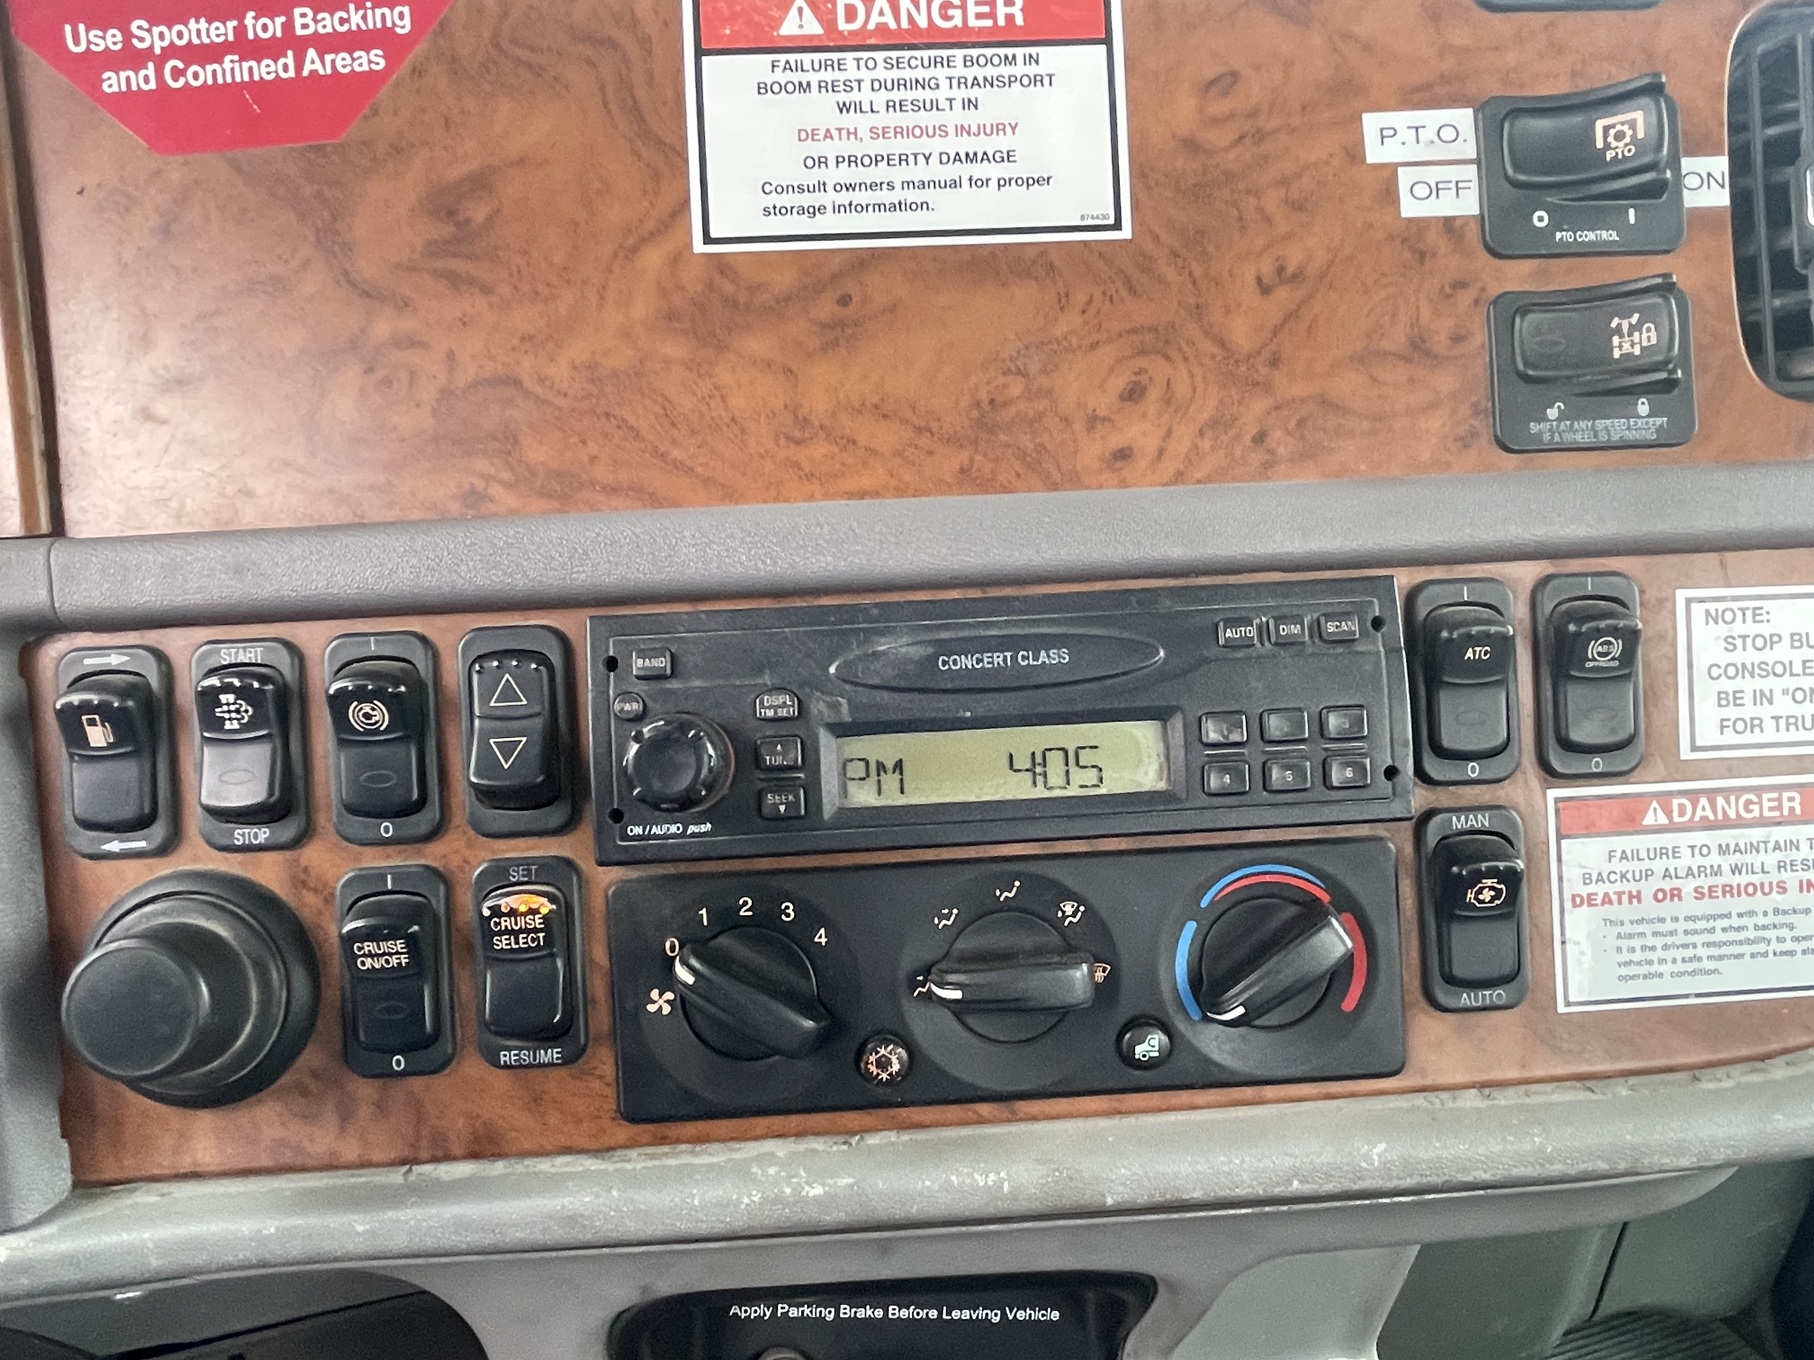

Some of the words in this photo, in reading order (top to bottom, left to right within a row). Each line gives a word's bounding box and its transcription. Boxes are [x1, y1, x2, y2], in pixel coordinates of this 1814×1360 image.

[837, 0, 1024, 31] DANGER
[65, 23, 122, 53] Use
[131, 18, 235, 55] Spotter
[244, 12, 286, 39] for
[294, 2, 411, 35] Backing
[102, 62, 156, 93] and
[164, 53, 295, 88] Confined
[303, 46, 387, 77] Areas
[771, 57, 848, 73] FAILURE
[854, 56, 877, 71] TO
[883, 54, 957, 70] SECURE
[963, 53, 1017, 68] BOOM
[1023, 52, 1040, 66] IN
[757, 80, 812, 95] BOOM
[818, 78, 864, 93] REST
[870, 76, 940, 92] DURING
[945, 73, 1055, 89] TRANSPORT
[836, 99, 879, 114] WILL
[885, 97, 956, 113] RESULT
[962, 97, 979, 111] IN
[797, 127, 863, 143] DEATH,
[869, 125, 949, 140] SERIOUS
[954, 122, 1019, 138] INJURY
[1380, 123, 1467, 146] P.T.O.
[803, 155, 829, 170] OR
[835, 152, 933, 168] PROPERTY
[939, 149, 1017, 165] DAMAGE
[1605, 145, 1635, 162] PTO
[761, 180, 828, 196] Consult
[834, 179, 895, 193] owners
[901, 176, 962, 191] manual
[968, 174, 992, 189] for
[998, 174, 1053, 191] proper
[1683, 171, 1725, 190] ON
[1410, 180, 1472, 201] OFF
[763, 201, 827, 218] storage
[832, 197, 935, 214] information.
[1555, 230, 1574, 242] PTO
[1576, 229, 1619, 241] CONTROL
[1530, 422, 1558, 434] SHIFT
[1559, 421, 1572, 432] AT
[1573, 420, 1593, 431] ANY
[1595, 419, 1627, 430] SPEED
[1630, 418, 1668, 429] EXCEPT
[1543, 433, 1552, 443] IF
[1554, 432, 1561, 442] A
[1562, 431, 1596, 442] WHEEL
[1598, 431, 1608, 441] IS
[1610, 429, 1657, 441] SPINNING
[1705, 606, 1770, 625] NOTE:
[1225, 627, 1254, 638] AUTO
[1280, 625, 1301, 635] DIM
[1327, 622, 1355, 632] SCAN
[1723, 633, 1783, 653] STOP
[220, 648, 264, 664] START
[938, 651, 1013, 671] CONCERT
[1017, 649, 1070, 667] CLASS
[1465, 645, 1491, 661] ATC
[636, 658, 666, 668] BAND
[1707, 660, 1814, 680] CONSOLE
[617, 702, 638, 711] PWR
[764, 695, 792, 706] DSPL
[1717, 690, 1746, 708] BE
[1753, 688, 1774, 706] IN
[777, 707, 795, 716] SET
[1720, 717, 1764, 735] FOR
[843, 757, 904, 798] PM
[767, 793, 795, 804] SEEK
[1672, 791, 1802, 823] DANGER
[686, 822, 712, 835] push
[1452, 813, 1490, 831] MAN
[233, 828, 270, 845] STOP
[1608, 846, 1682, 864] FAILURE
[1687, 844, 1711, 858] TO
[1717, 839, 1801, 857] MAINTAIN
[509, 866, 538, 882] SET
[1582, 869, 1655, 886] BACKUP
[1662, 865, 1722, 881] ALARM
[1729, 860, 1770, 877] WILL
[1777, 858, 1814, 874] RES
[1571, 890, 1643, 909] DEATH
[1652, 887, 1683, 904] OR
[1693, 880, 1789, 901] SERIOUS
[738, 897, 754, 916] 2
[780, 902, 795, 921] 3
[490, 915, 545, 932] CRUISE
[698, 908, 708, 926] 1
[1603, 917, 1625, 928] This
[1629, 915, 1667, 926] vehicle
[1671, 914, 1680, 923] is
[1683, 911, 1732, 925] equipped
[1736, 909, 1758, 918] with
[1773, 906, 1812, 917] Backup
[493, 931, 546, 949] SELECT
[814, 927, 828, 946] 4
[1616, 930, 1647, 940] Alarm
[1652, 928, 1678, 938] must
[1683, 926, 1716, 936] sound
[1721, 923, 1748, 933] when
[1753, 921, 1798, 932] backing.
[353, 939, 408, 956] CRUISE
[1627, 945, 1636, 954] is
[1640, 943, 1657, 953] the
[1661, 940, 1698, 951] drivers
[1702, 935, 1772, 950] responsibility
[1776, 935, 1787, 944] to
[356, 953, 409, 970] ON/OFF
[1617, 957, 1655, 969] vehicle
[1658, 957, 1668, 966] in
[1681, 954, 1703, 964] safe
[1707, 952, 1746, 962] manner
[1750, 950, 1769, 960] and
[1773, 948, 1798, 960] keep
[1617, 971, 1664, 983] operable
[1670, 967, 1723, 979] condition.
[1459, 989, 1507, 1008] AUTO
[500, 1048, 563, 1067] RESUME
[729, 1304, 773, 1321] Apply
[777, 1304, 836, 1321] Parking
[839, 1304, 884, 1319] Brake
[888, 1305, 938, 1320] Before
[942, 1306, 1001, 1323] Leaving
[1005, 1306, 1060, 1322] Vehicle
